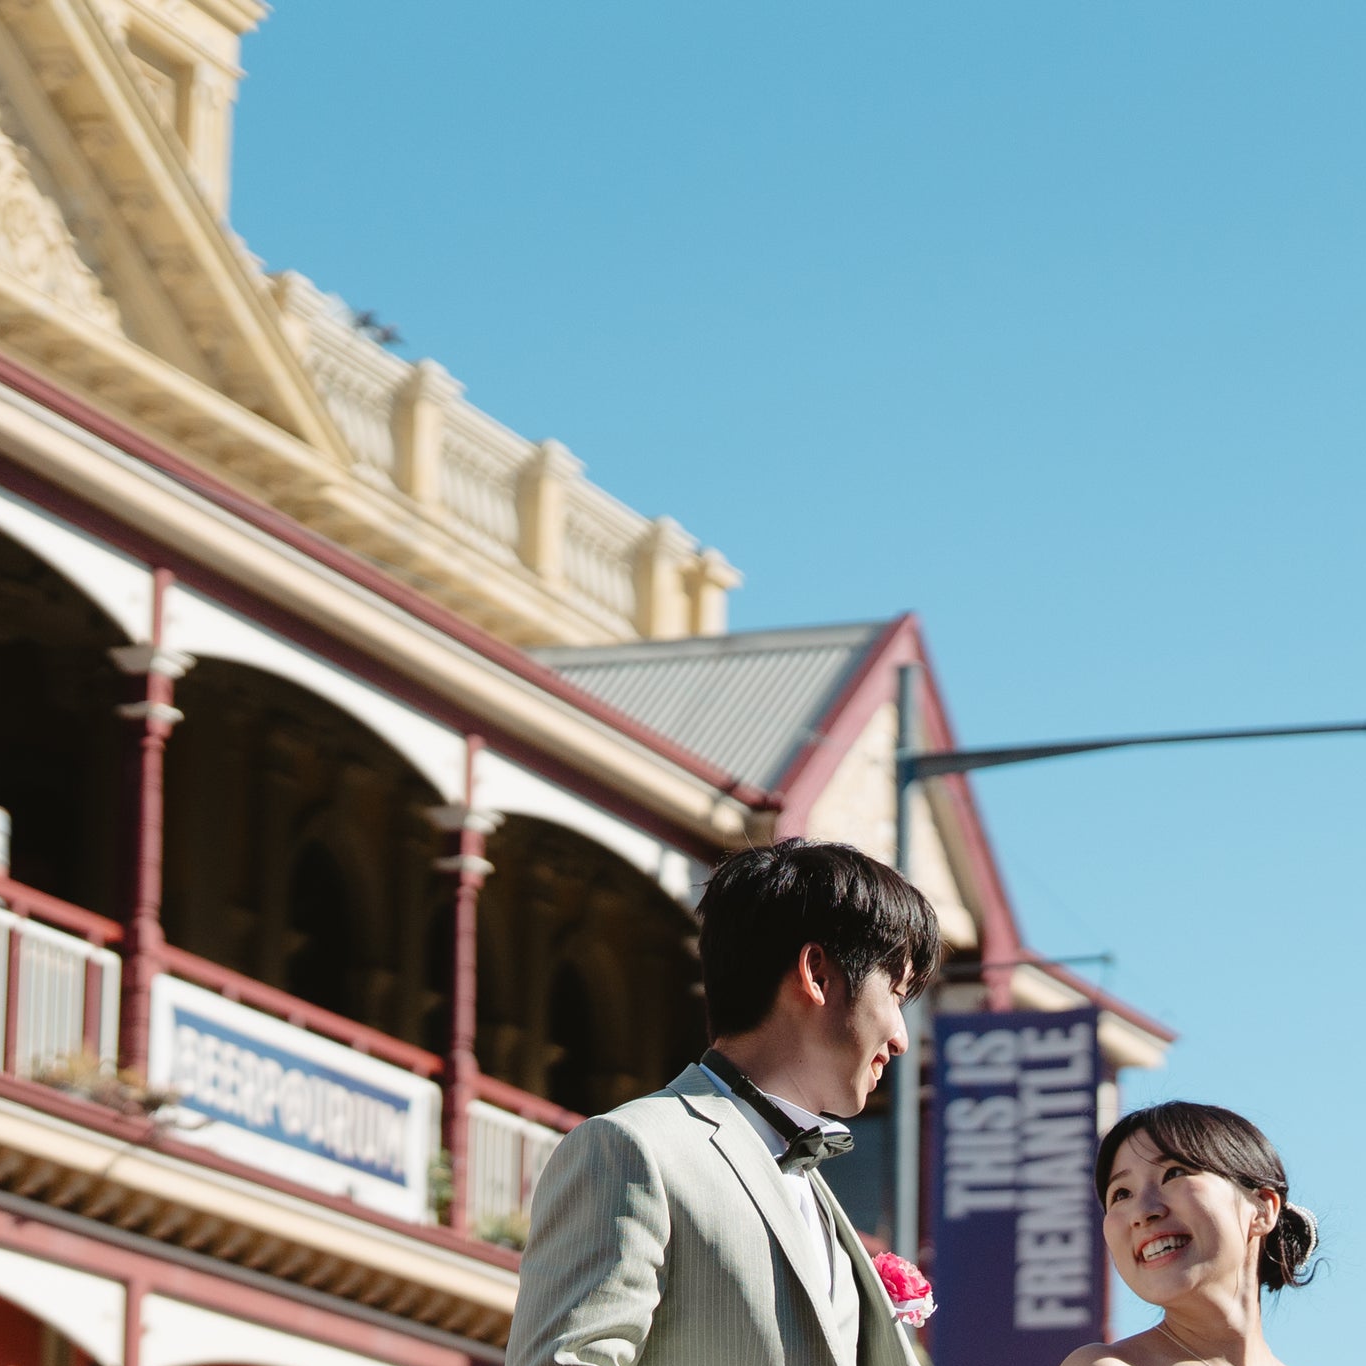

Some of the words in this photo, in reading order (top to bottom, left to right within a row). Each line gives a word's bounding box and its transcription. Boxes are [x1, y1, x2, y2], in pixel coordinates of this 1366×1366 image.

[944, 1029, 1018, 1085] IS
[944, 1096, 1018, 1220] THIS
[1013, 1023, 1093, 1330] FREMANTLE
